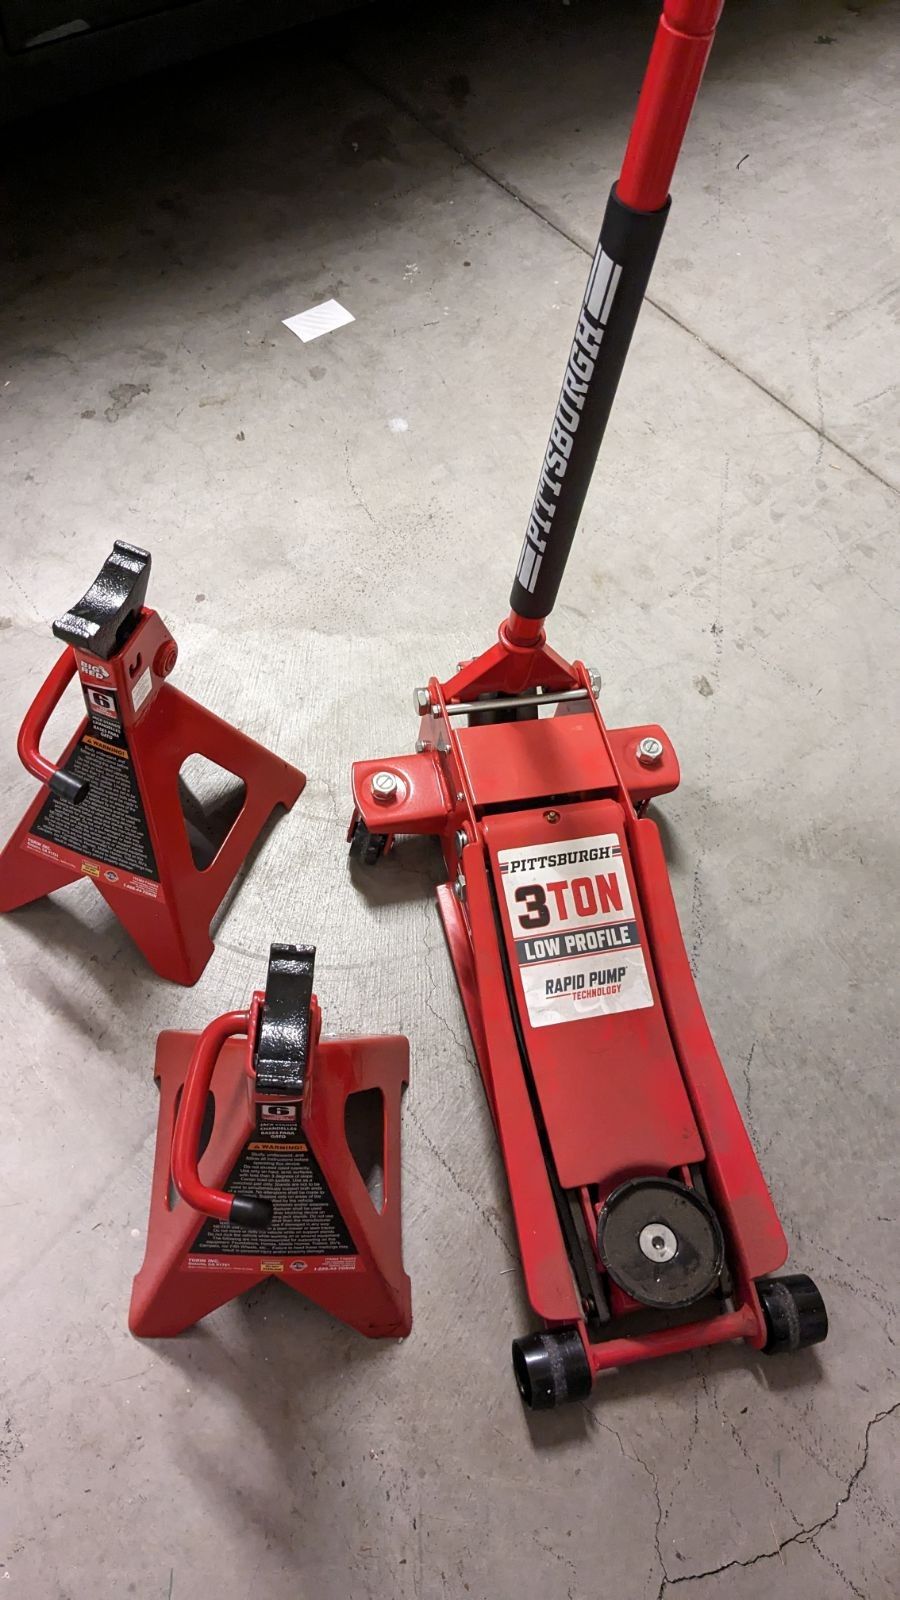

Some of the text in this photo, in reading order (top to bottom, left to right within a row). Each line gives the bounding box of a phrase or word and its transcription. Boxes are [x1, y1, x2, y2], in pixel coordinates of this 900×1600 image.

[526, 306, 606, 554] PITTSBURGH
[80, 660, 101, 672] BIG
[81, 666, 104, 680] RED
[93, 692, 110, 709] 6
[510, 846, 612, 873] PITTSBURGH
[524, 925, 631, 961] LOW PROFILE
[545, 966, 626, 995] RAPID PUMP
[572, 984, 622, 1001] TECHNOLOGY
[267, 1106, 290, 1116] 6
